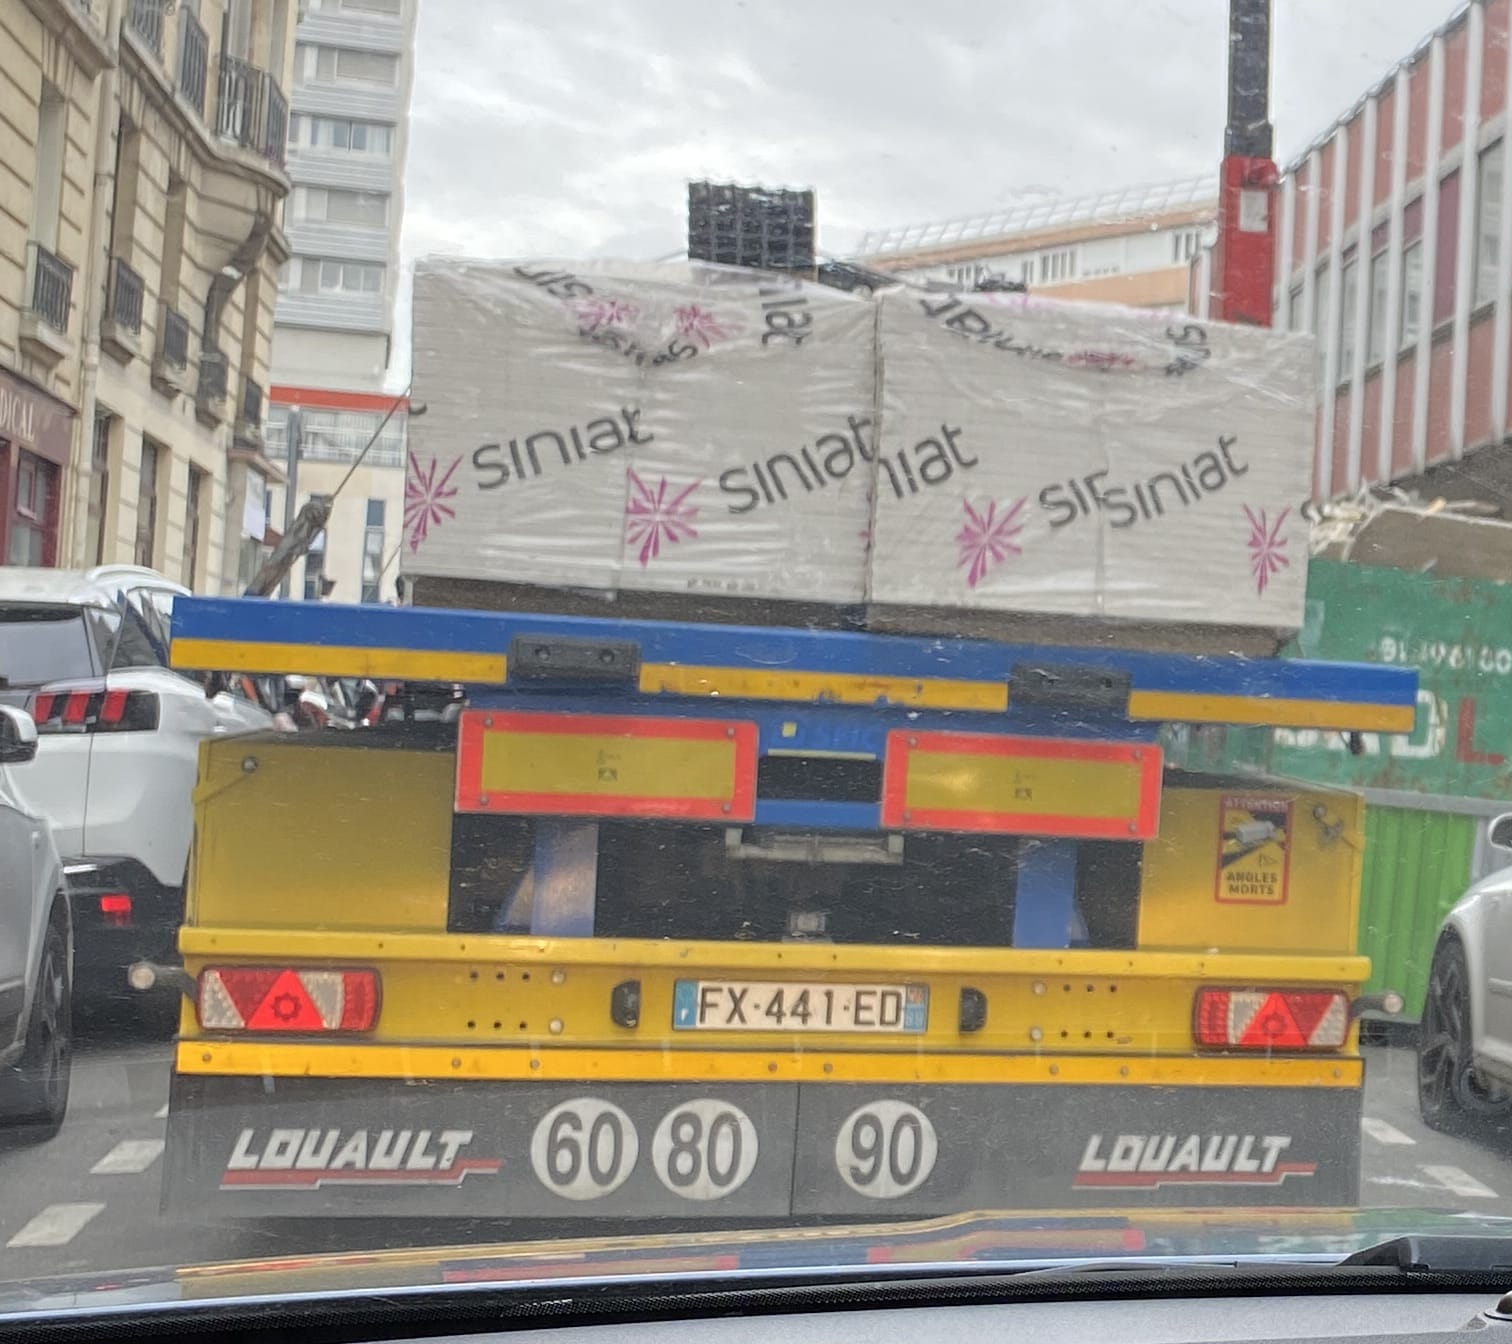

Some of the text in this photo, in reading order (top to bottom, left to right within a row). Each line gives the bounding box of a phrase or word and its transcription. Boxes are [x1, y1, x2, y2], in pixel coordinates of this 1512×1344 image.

[1228, 883, 1275, 896] MORTS
[228, 1129, 473, 1170] LOUAULT
[548, 1110, 625, 1187] 60
[667, 1110, 742, 1187] 80
[851, 1113, 921, 1186] 90
[1080, 1134, 1292, 1172] LOUAULT
